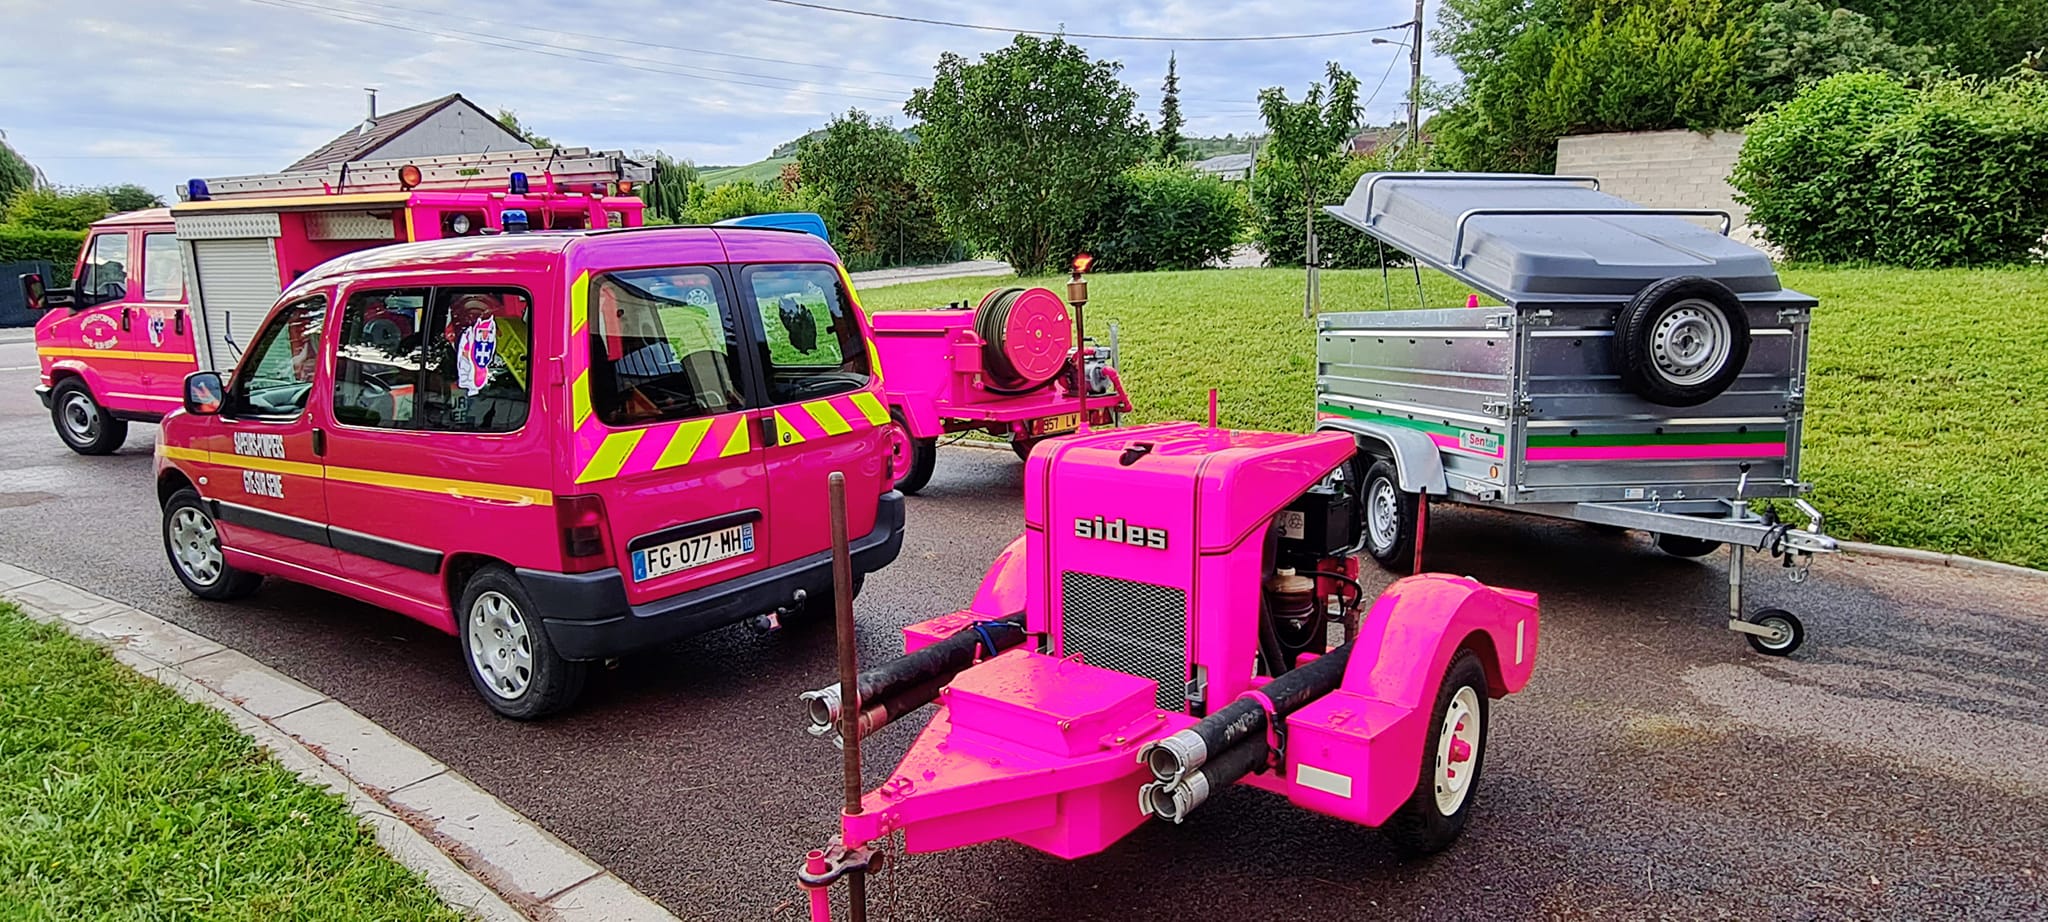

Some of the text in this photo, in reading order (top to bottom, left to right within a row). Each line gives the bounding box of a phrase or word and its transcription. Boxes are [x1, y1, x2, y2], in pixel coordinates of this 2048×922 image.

[743, 538, 753, 551] 10
[1074, 515, 1167, 549] sides
[647, 528, 742, 573] FG-077-MH
